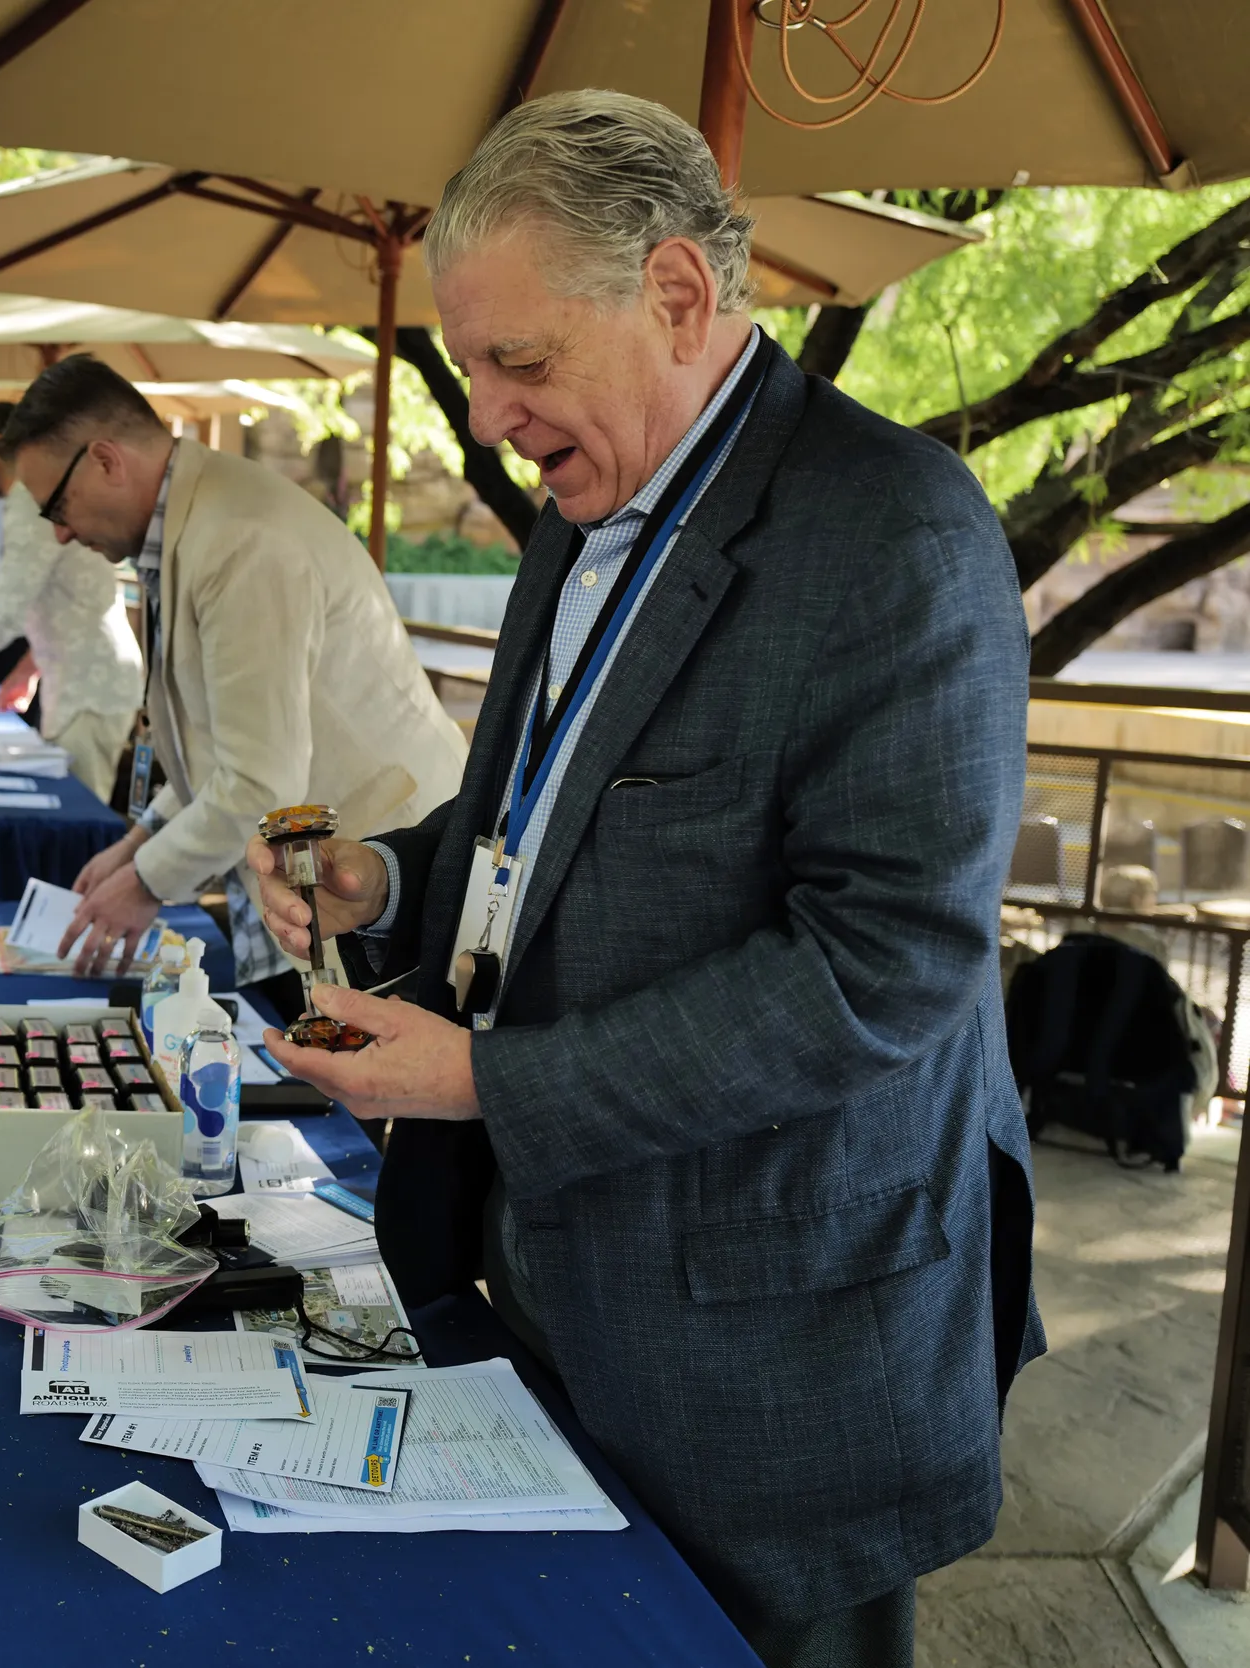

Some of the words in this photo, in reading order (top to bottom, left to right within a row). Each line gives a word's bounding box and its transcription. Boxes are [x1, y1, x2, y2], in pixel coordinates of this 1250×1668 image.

[60, 1340, 72, 1372] Photographs
[184, 1345, 193, 1364] Jewelry
[61, 1386, 86, 1394] AR
[120, 1430, 134, 1444] ITEM
[252, 1443, 263, 1452] #2
[247, 1451, 259, 1466] ITEM
[371, 1459, 380, 1482] DETOURS
